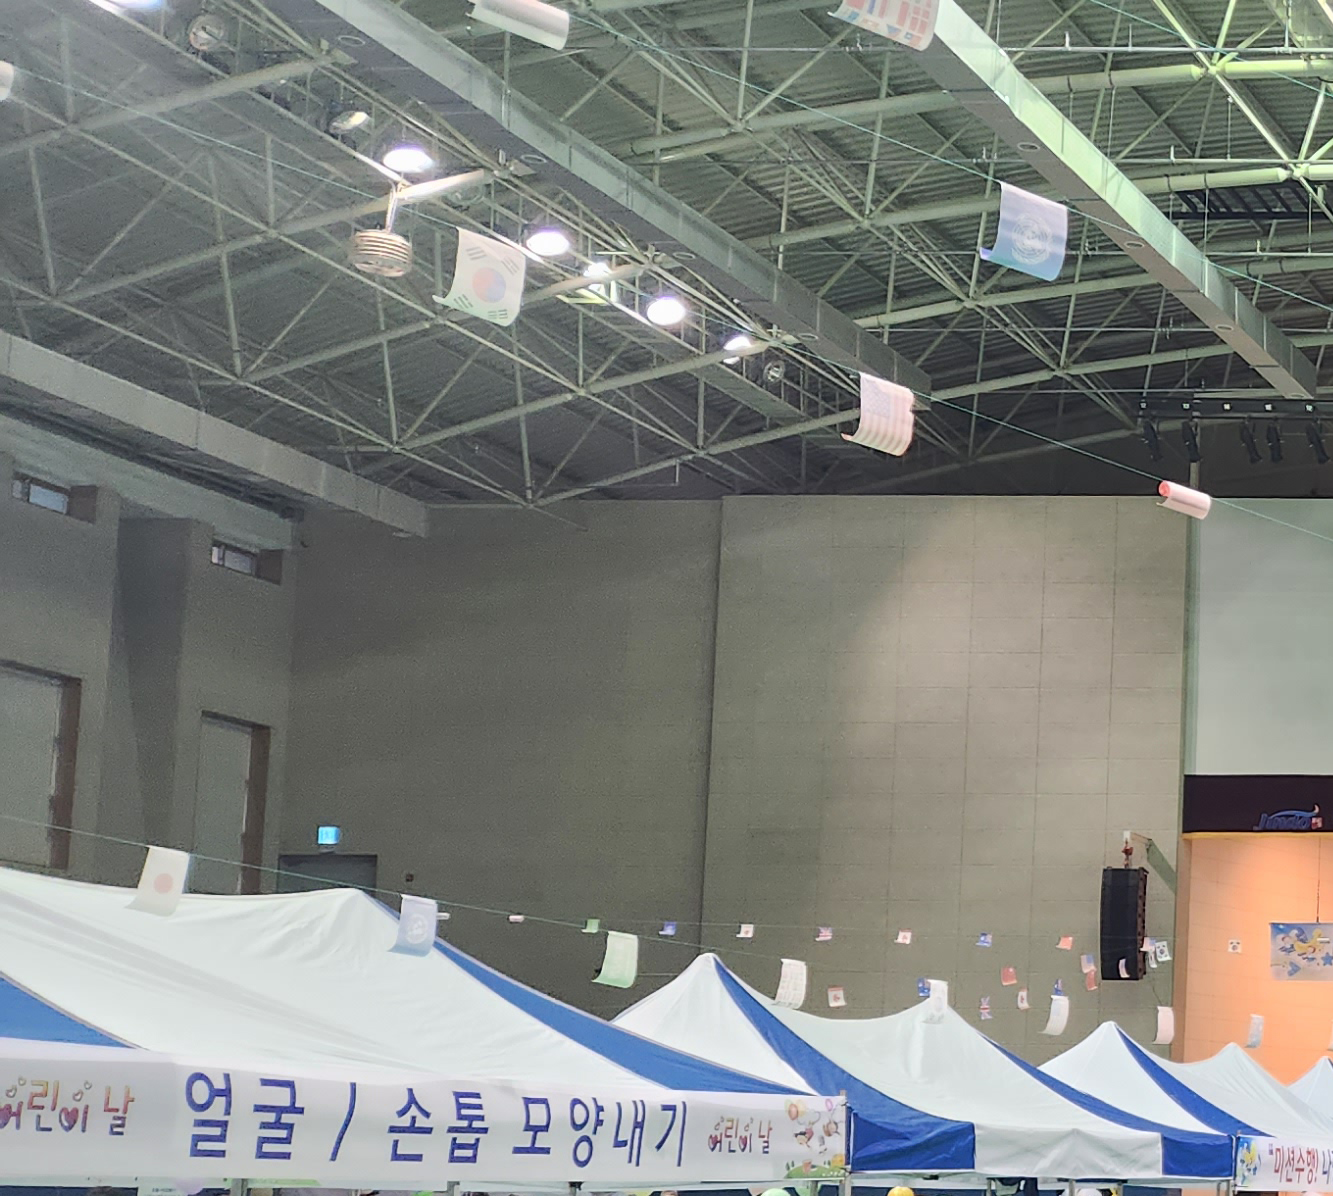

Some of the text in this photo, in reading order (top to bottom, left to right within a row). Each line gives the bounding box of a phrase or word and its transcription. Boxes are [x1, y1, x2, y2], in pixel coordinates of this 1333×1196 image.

[103, 1084, 136, 1136] 날
[185, 1071, 688, 1169] 얼굴 / 손톱 모양내기
[707, 1115, 773, 1155] 어린이 날
